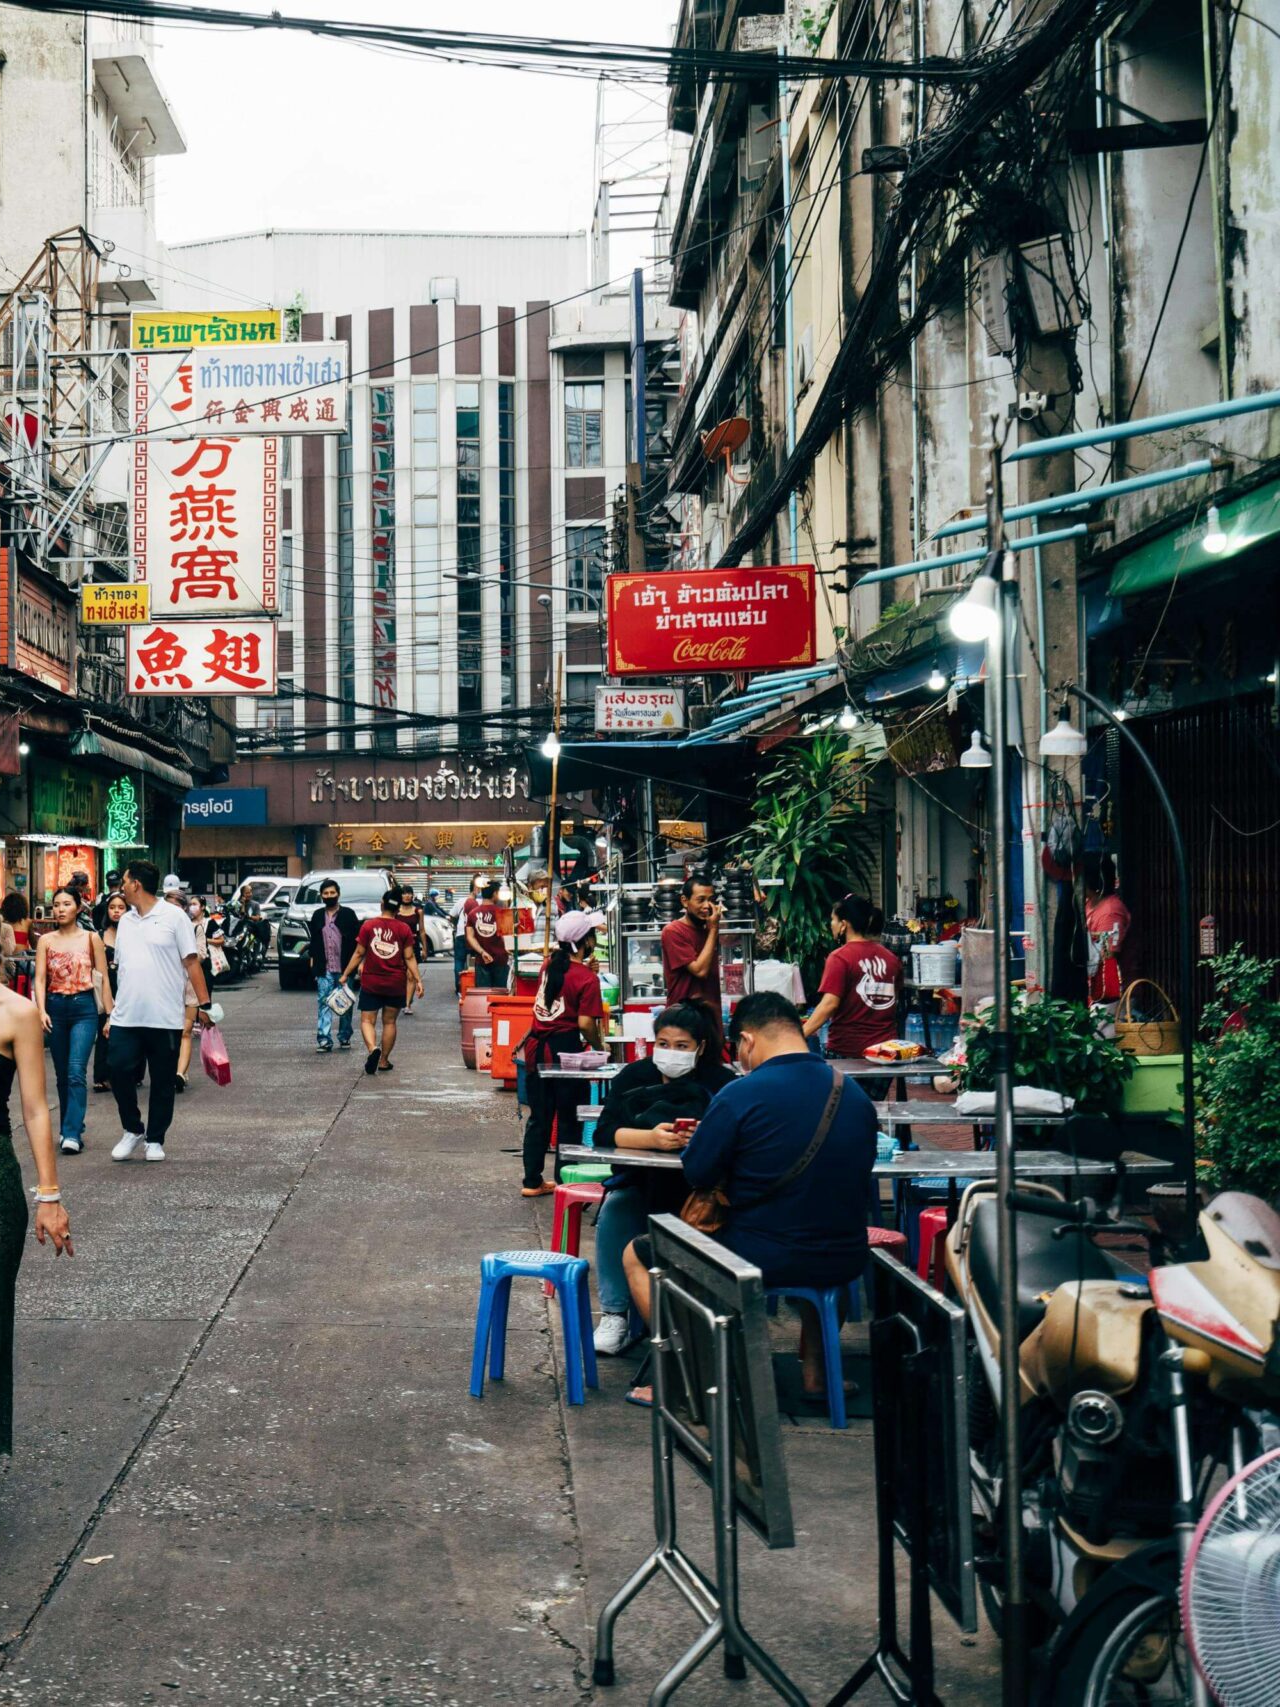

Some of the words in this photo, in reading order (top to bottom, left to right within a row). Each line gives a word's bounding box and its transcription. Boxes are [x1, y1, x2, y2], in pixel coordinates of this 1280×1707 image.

[138, 316, 276, 349] บูรพารังนก
[200, 355, 342, 388] ห้างทองทงเซ่งเฮง
[94, 587, 138, 601] ห้างทอง
[678, 581, 789, 604] ข้าวต้มปลา
[86, 601, 146, 620] ทงเซ่งเฮง
[134, 626, 267, 691] 魚翅
[673, 636, 750, 663] Coca-Cola
[604, 691, 675, 709] แสงอรุณ
